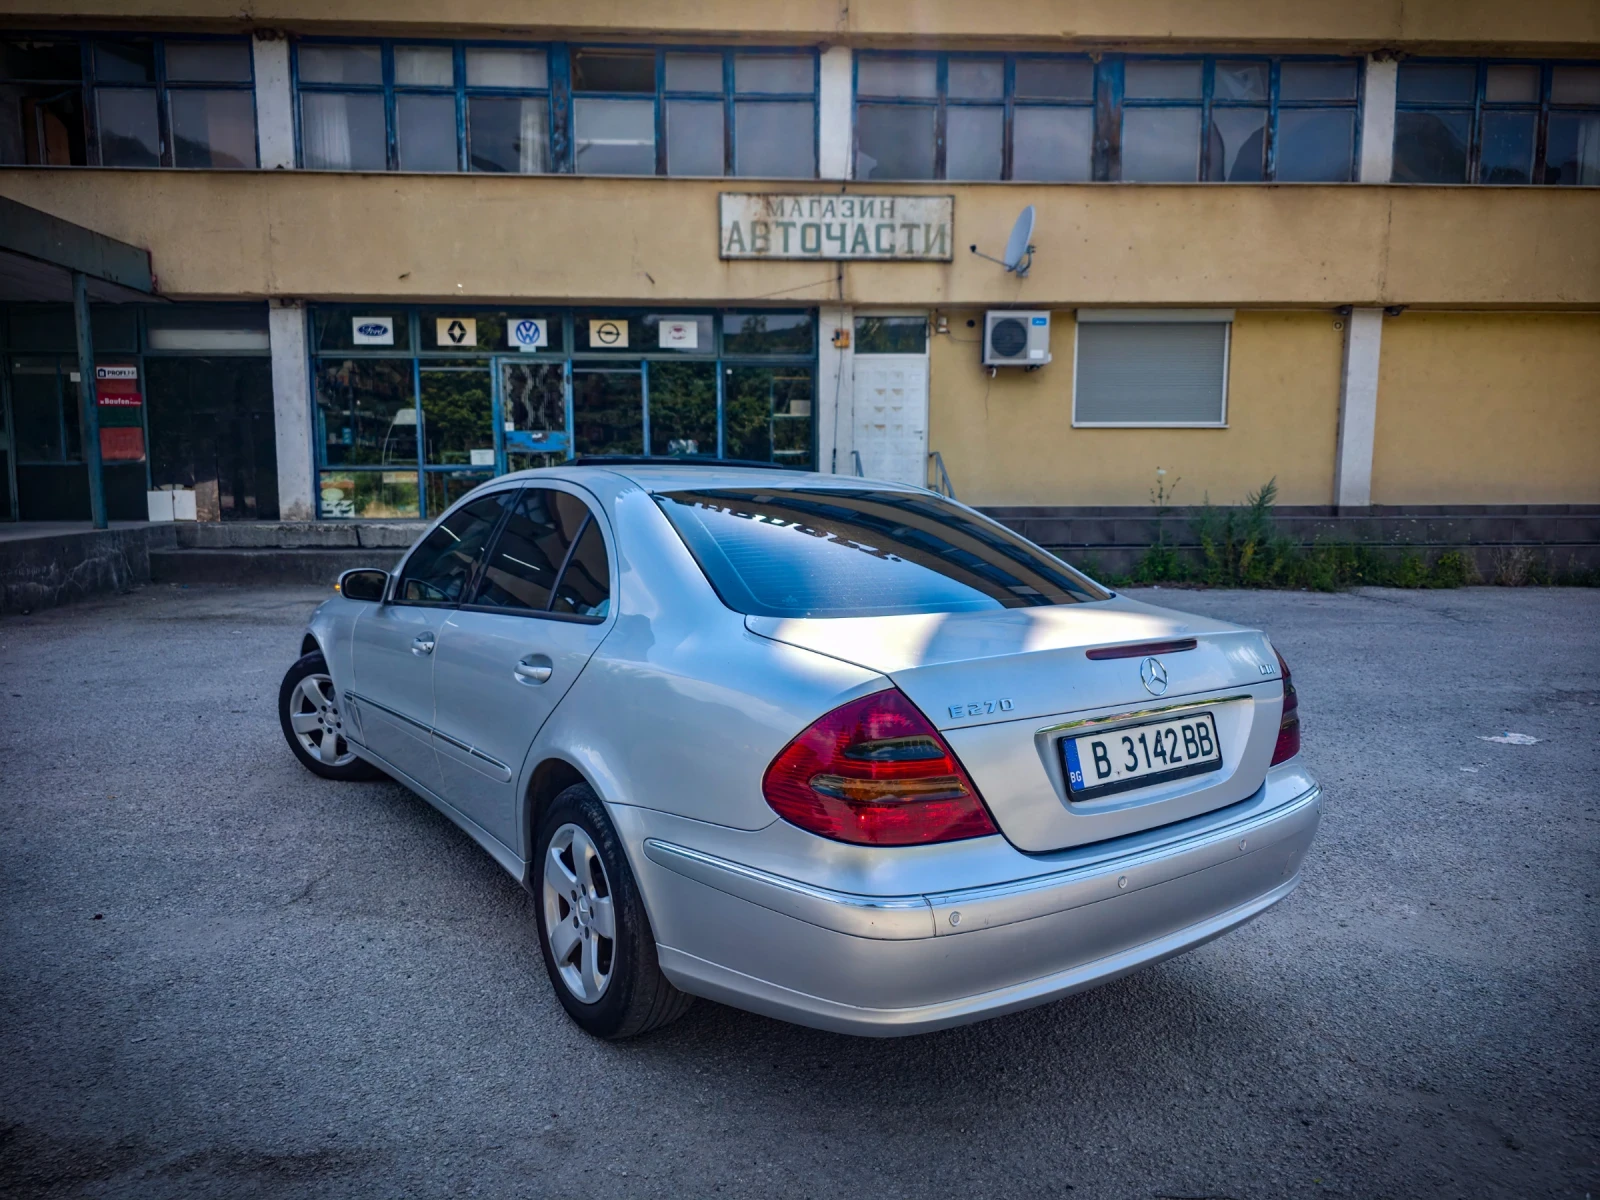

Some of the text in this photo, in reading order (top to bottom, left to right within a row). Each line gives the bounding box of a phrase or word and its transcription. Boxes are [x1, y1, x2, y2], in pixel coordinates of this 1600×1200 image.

[767, 199, 895, 219] МАГАЗИН
[726, 221, 946, 255] АВТОЧАСТИ
[1070, 770, 1082, 783] BG
